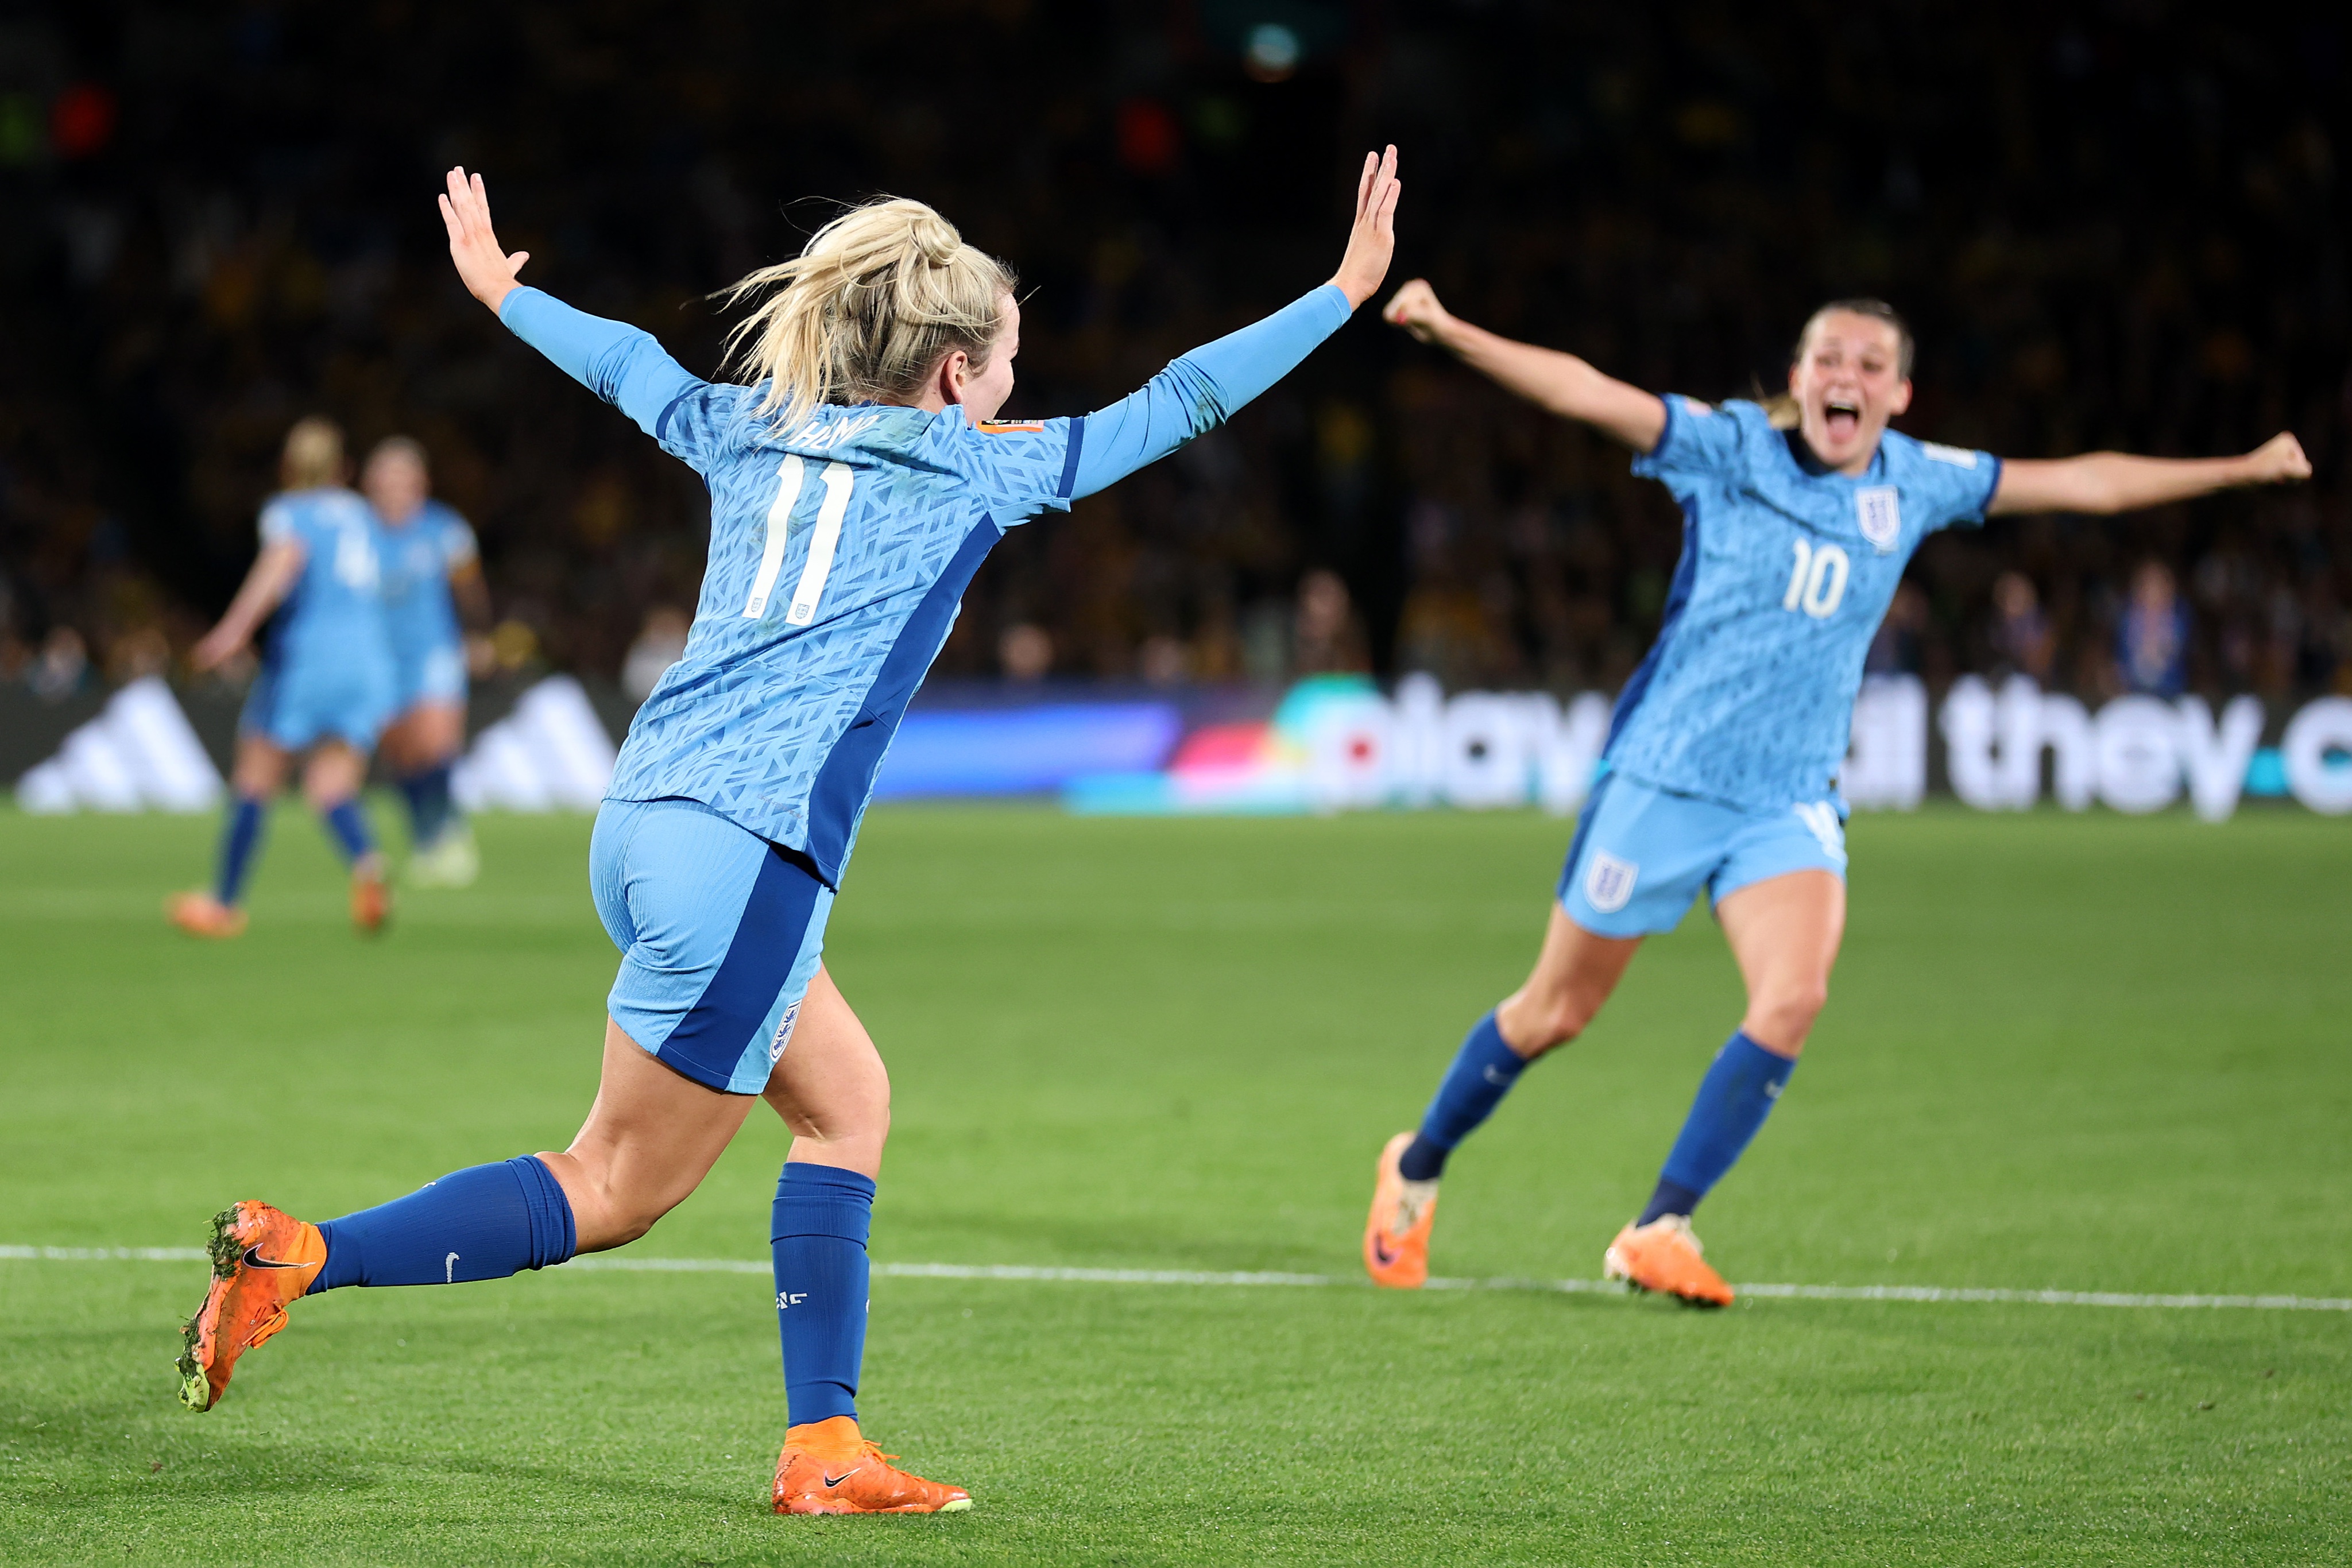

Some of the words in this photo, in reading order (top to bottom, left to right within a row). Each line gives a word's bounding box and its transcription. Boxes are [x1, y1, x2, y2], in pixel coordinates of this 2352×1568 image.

[741, 453, 854, 626] 11
[1784, 537, 1850, 619] 10
[1308, 672, 1609, 816] play
[1941, 673, 2264, 822] they
